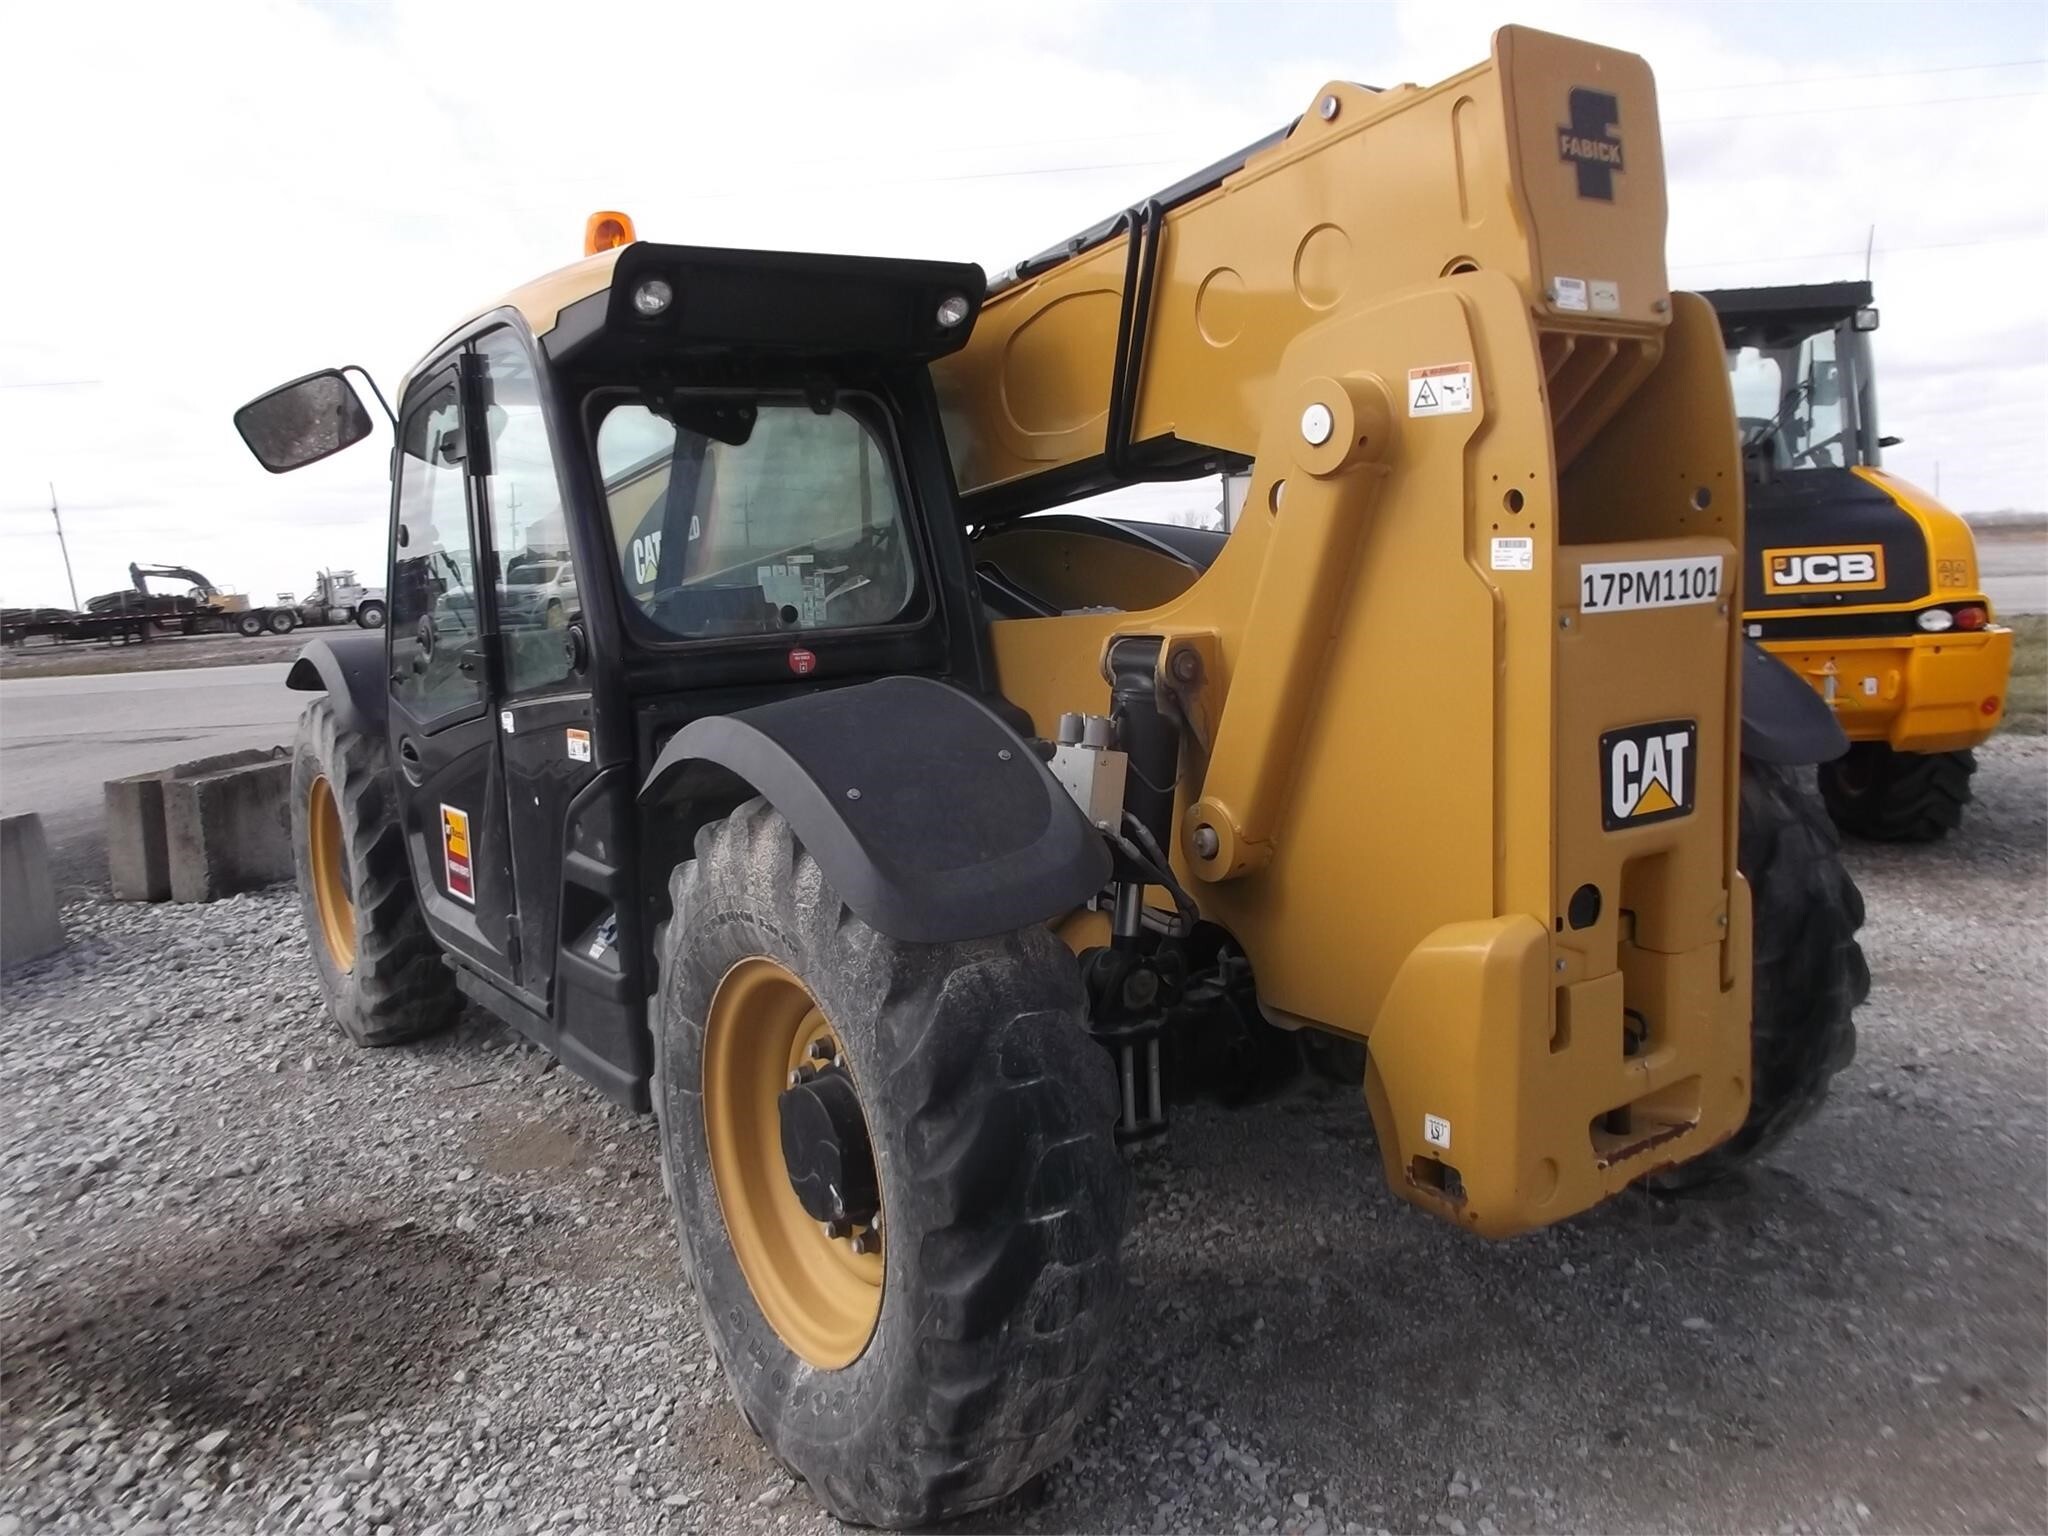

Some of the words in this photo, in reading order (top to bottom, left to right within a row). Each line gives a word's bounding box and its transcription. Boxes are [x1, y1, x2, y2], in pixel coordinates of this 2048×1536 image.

[1561, 135, 1621, 163] FABICK
[1583, 566, 1718, 608] 17PM1101
[1774, 554, 1875, 585] JCB
[1612, 731, 1689, 818] CAT
